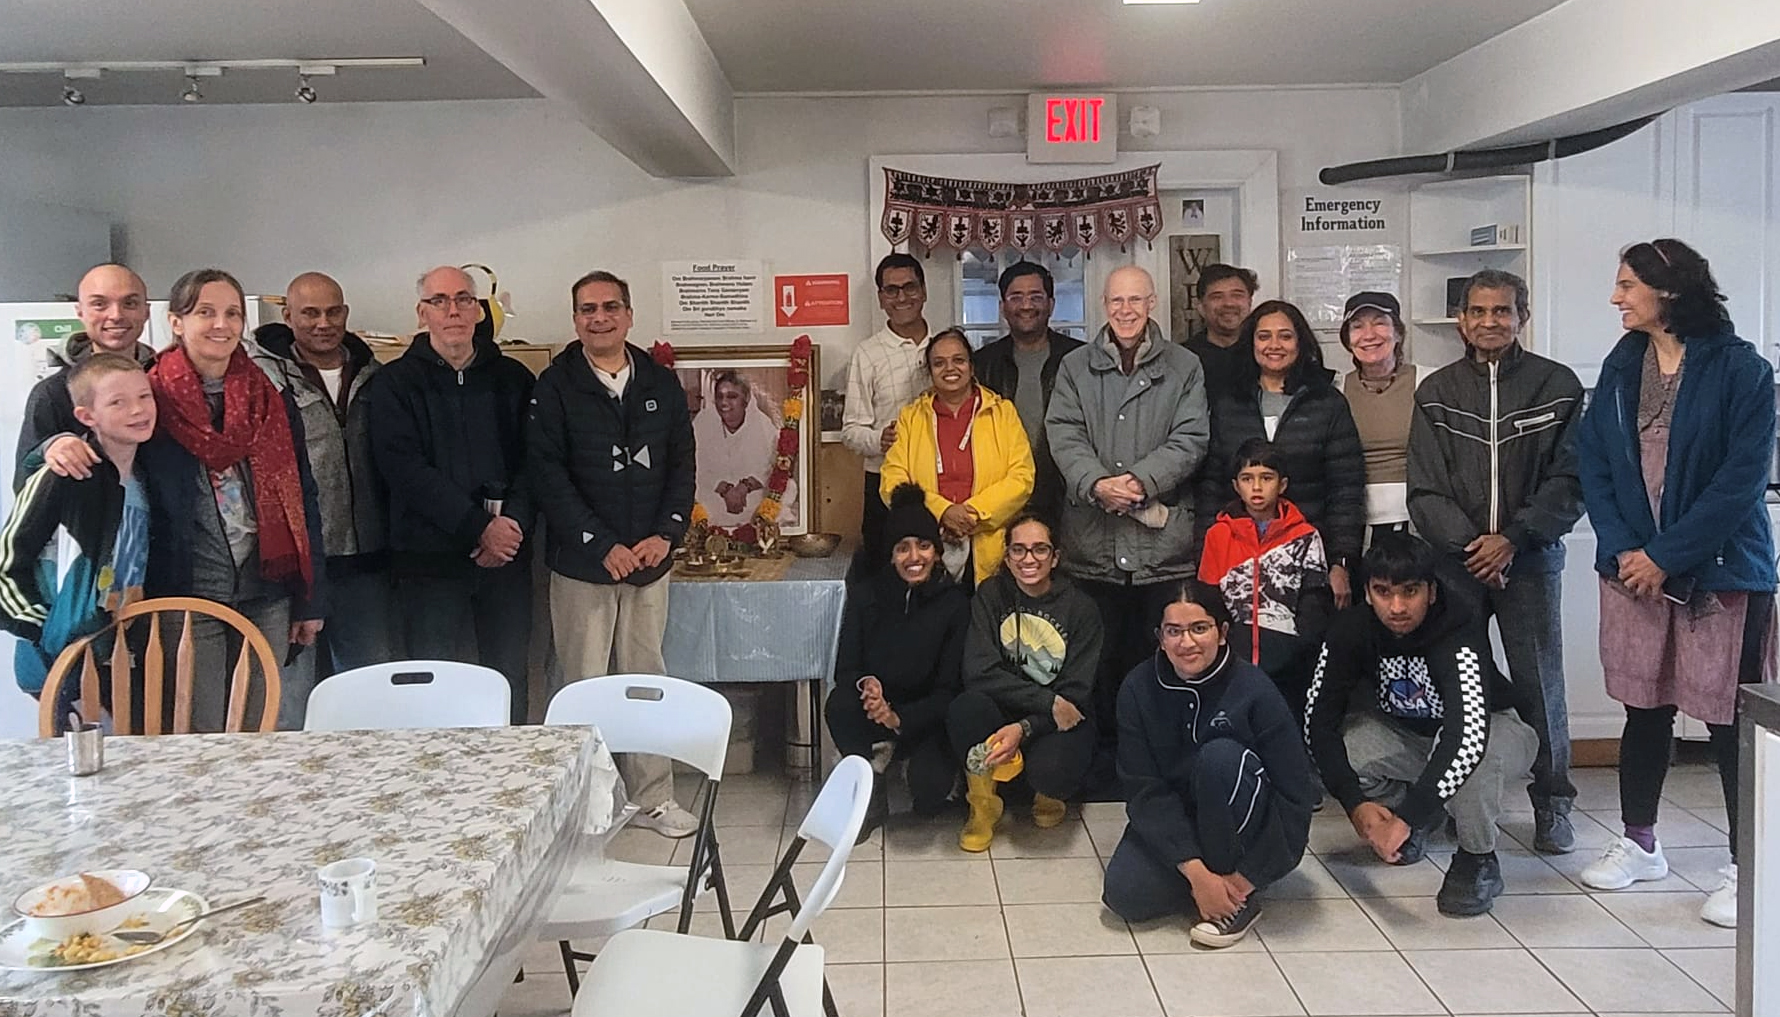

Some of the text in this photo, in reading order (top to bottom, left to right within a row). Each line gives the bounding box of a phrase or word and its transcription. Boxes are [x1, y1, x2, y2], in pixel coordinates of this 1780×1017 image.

[1046, 98, 1104, 143] EXIT
[1305, 197, 1382, 215] Emergency
[1301, 215, 1386, 232] Information
[692, 264, 710, 272] Food
